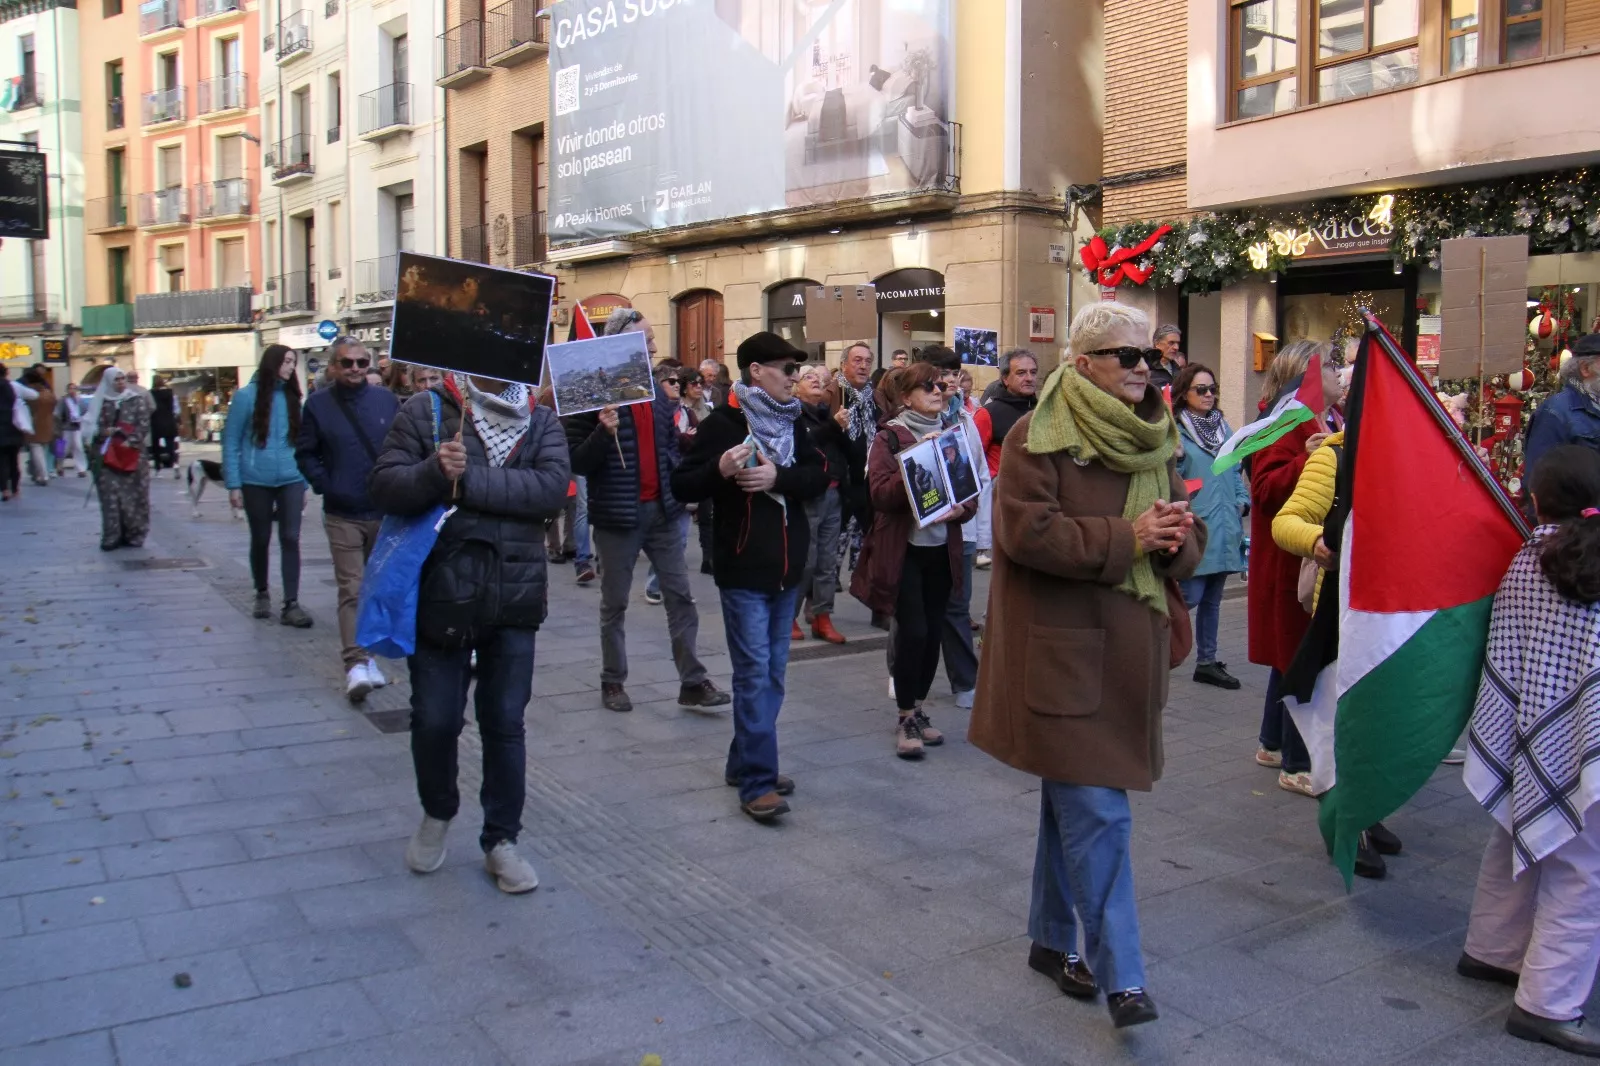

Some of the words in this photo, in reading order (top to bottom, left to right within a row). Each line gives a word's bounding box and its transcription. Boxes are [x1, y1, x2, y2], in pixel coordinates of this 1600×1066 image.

[556, 1, 618, 49] CASA
[584, 66, 613, 82] Viviendas
[614, 62, 623, 72] de
[599, 72, 639, 91] Dormitorios
[556, 131, 583, 155] Vivir
[585, 120, 626, 148] donde
[628, 112, 666, 136] otros
[558, 156, 582, 179] solo
[583, 145, 632, 176] pasean
[670, 180, 712, 199] GARLAN
[564, 209, 593, 227] Peak
[593, 202, 633, 222] Homes
[1357, 239, 1370, 247] que
[1371, 238, 1392, 246] inspir
[876, 286, 946, 300] PACOMARTINEZ
[349, 328, 381, 342] HOME
